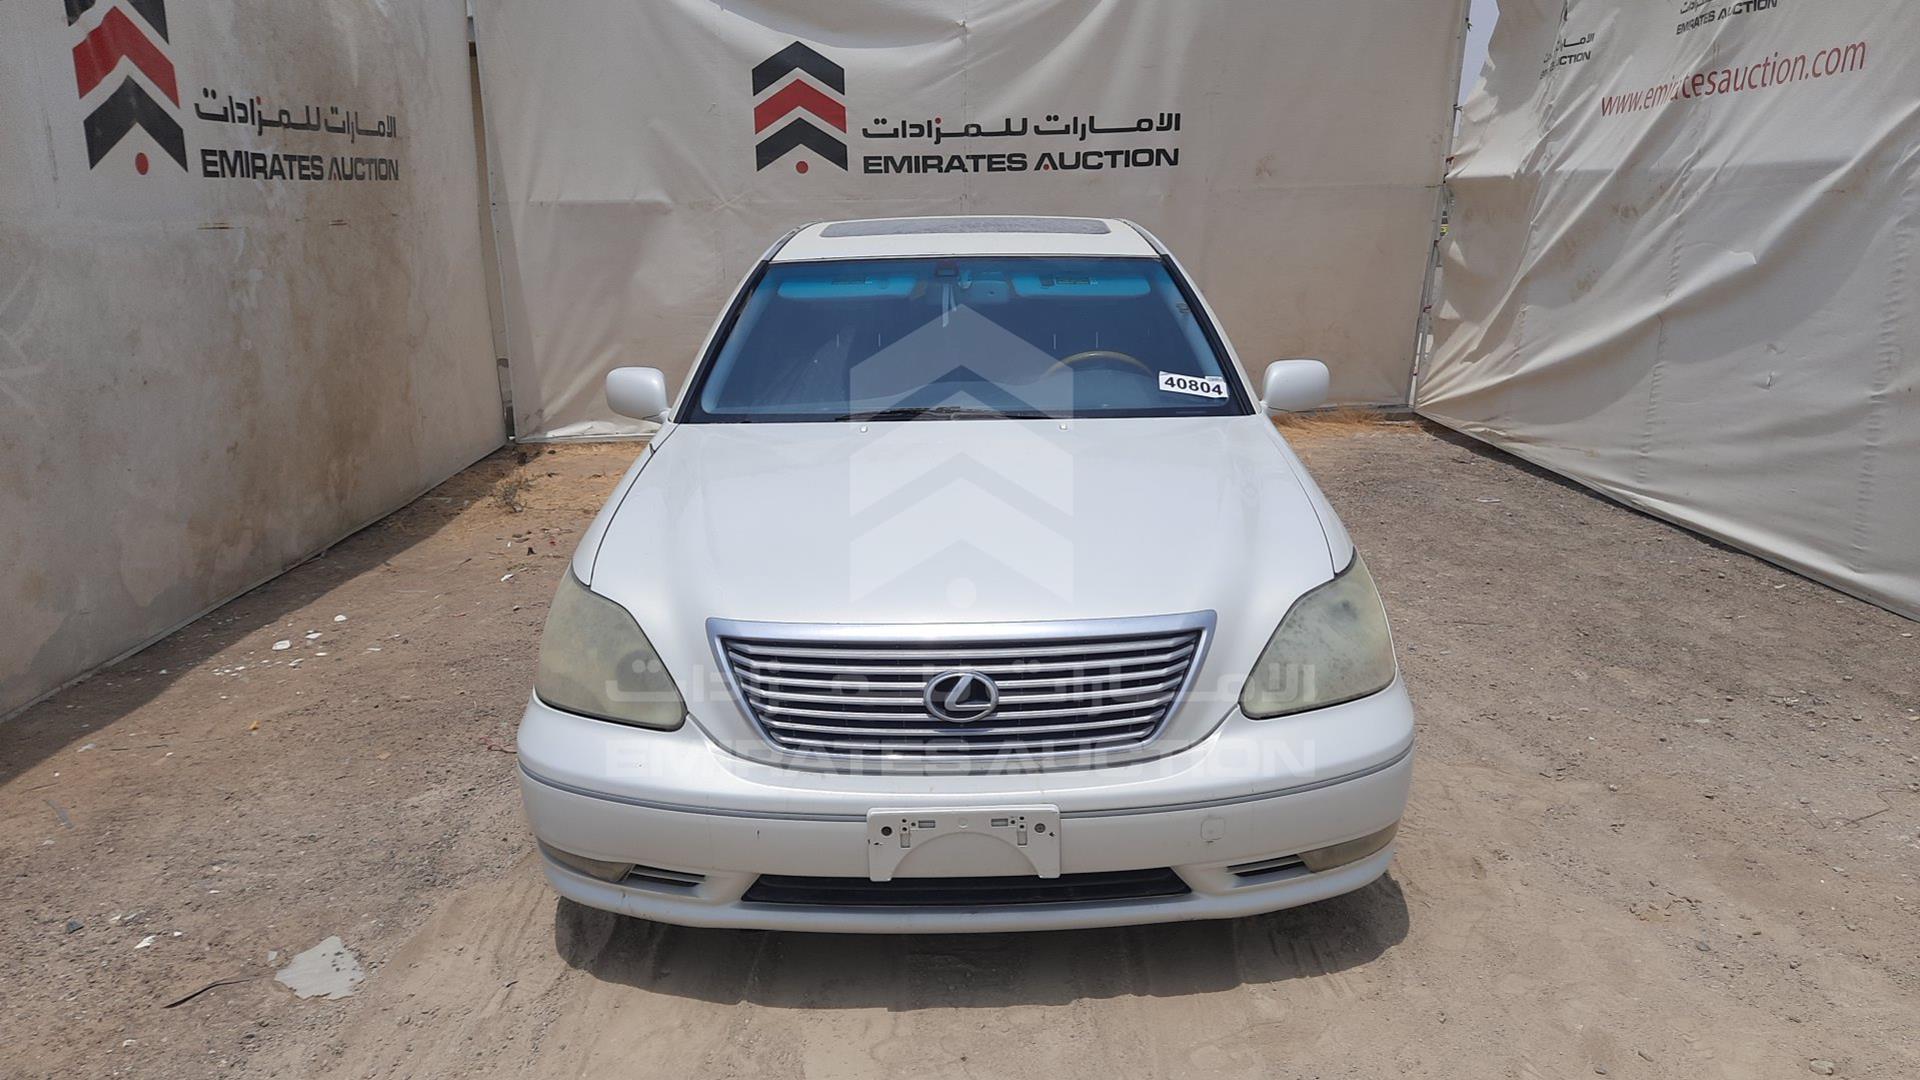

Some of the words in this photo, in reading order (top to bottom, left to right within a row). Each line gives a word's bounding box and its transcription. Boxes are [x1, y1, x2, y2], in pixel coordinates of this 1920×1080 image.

[200, 149, 324, 180] EMIRATES
[328, 157, 399, 181] AUCTION
[863, 152, 1028, 174] EMIRATES
[1034, 148, 1179, 171] AUCTION
[1164, 376, 1223, 395] 40804
